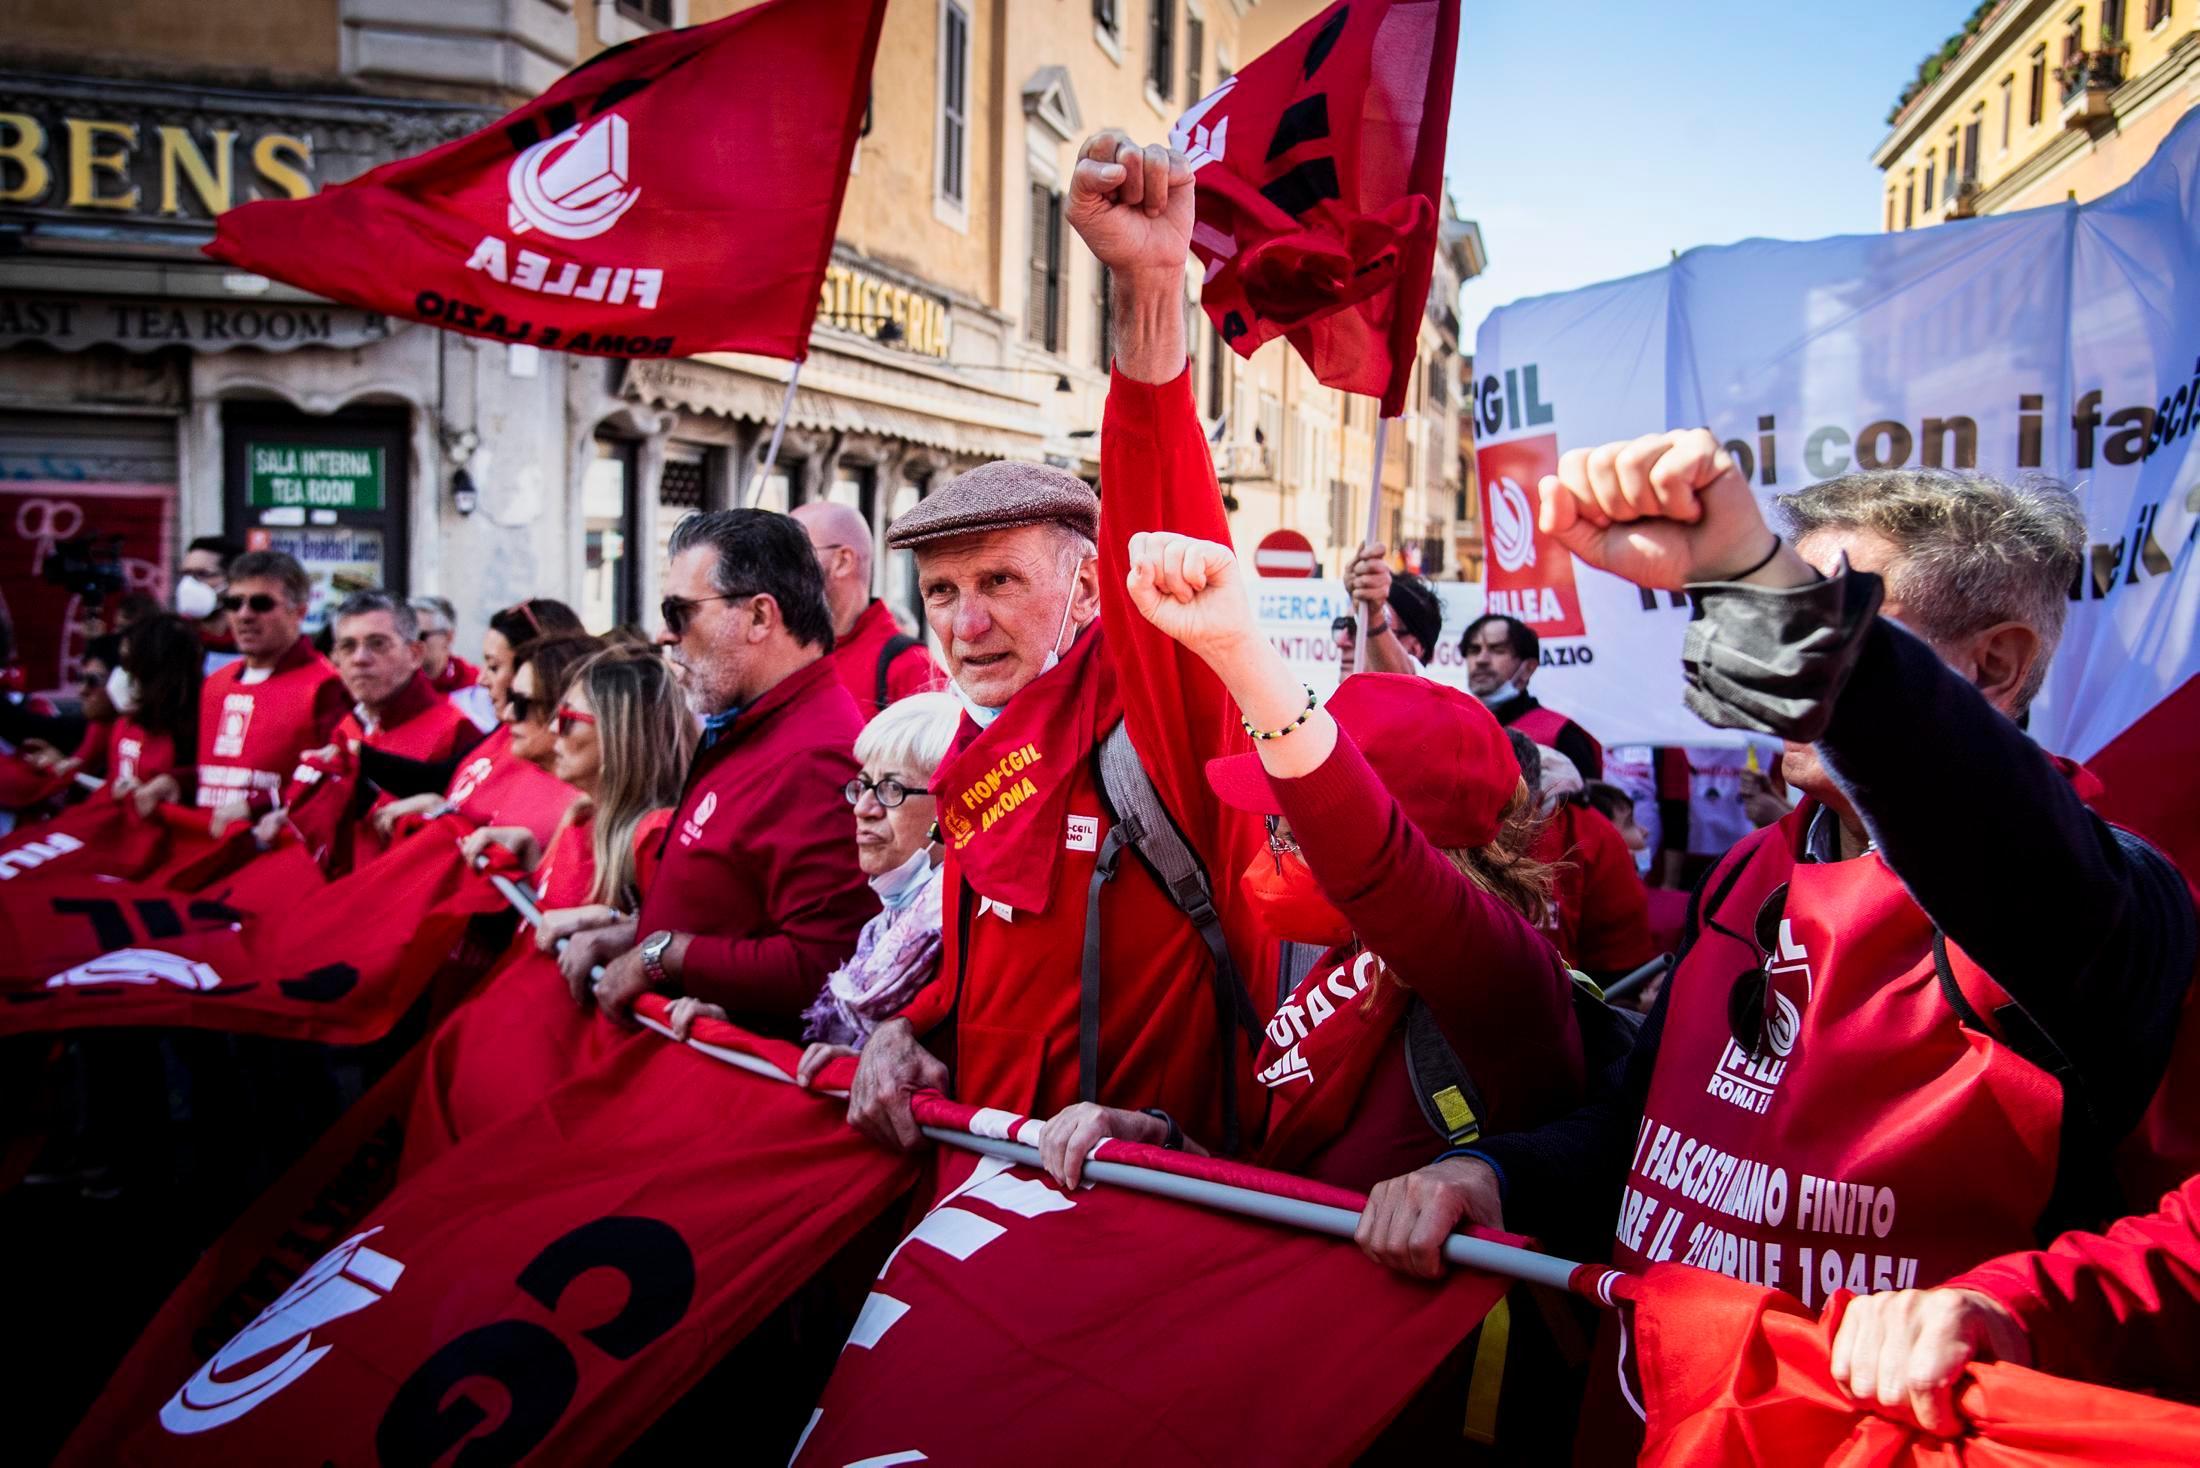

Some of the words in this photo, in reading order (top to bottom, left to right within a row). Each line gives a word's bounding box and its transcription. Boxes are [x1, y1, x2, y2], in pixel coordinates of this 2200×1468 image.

[110, 306, 190, 339] TEA
[203, 308, 332, 341] ROOM
[1804, 415, 1977, 478] con
[2017, 394, 2044, 468] i
[255, 448, 298, 475] SALA
[302, 450, 373, 478] INTERNA
[271, 478, 304, 504] TEA
[305, 479, 356, 506] ROOM
[1540, 644, 1594, 668] AZIO
[1706, 1073, 1757, 1111] ROMA
[1796, 1173, 1896, 1239] FINITO
